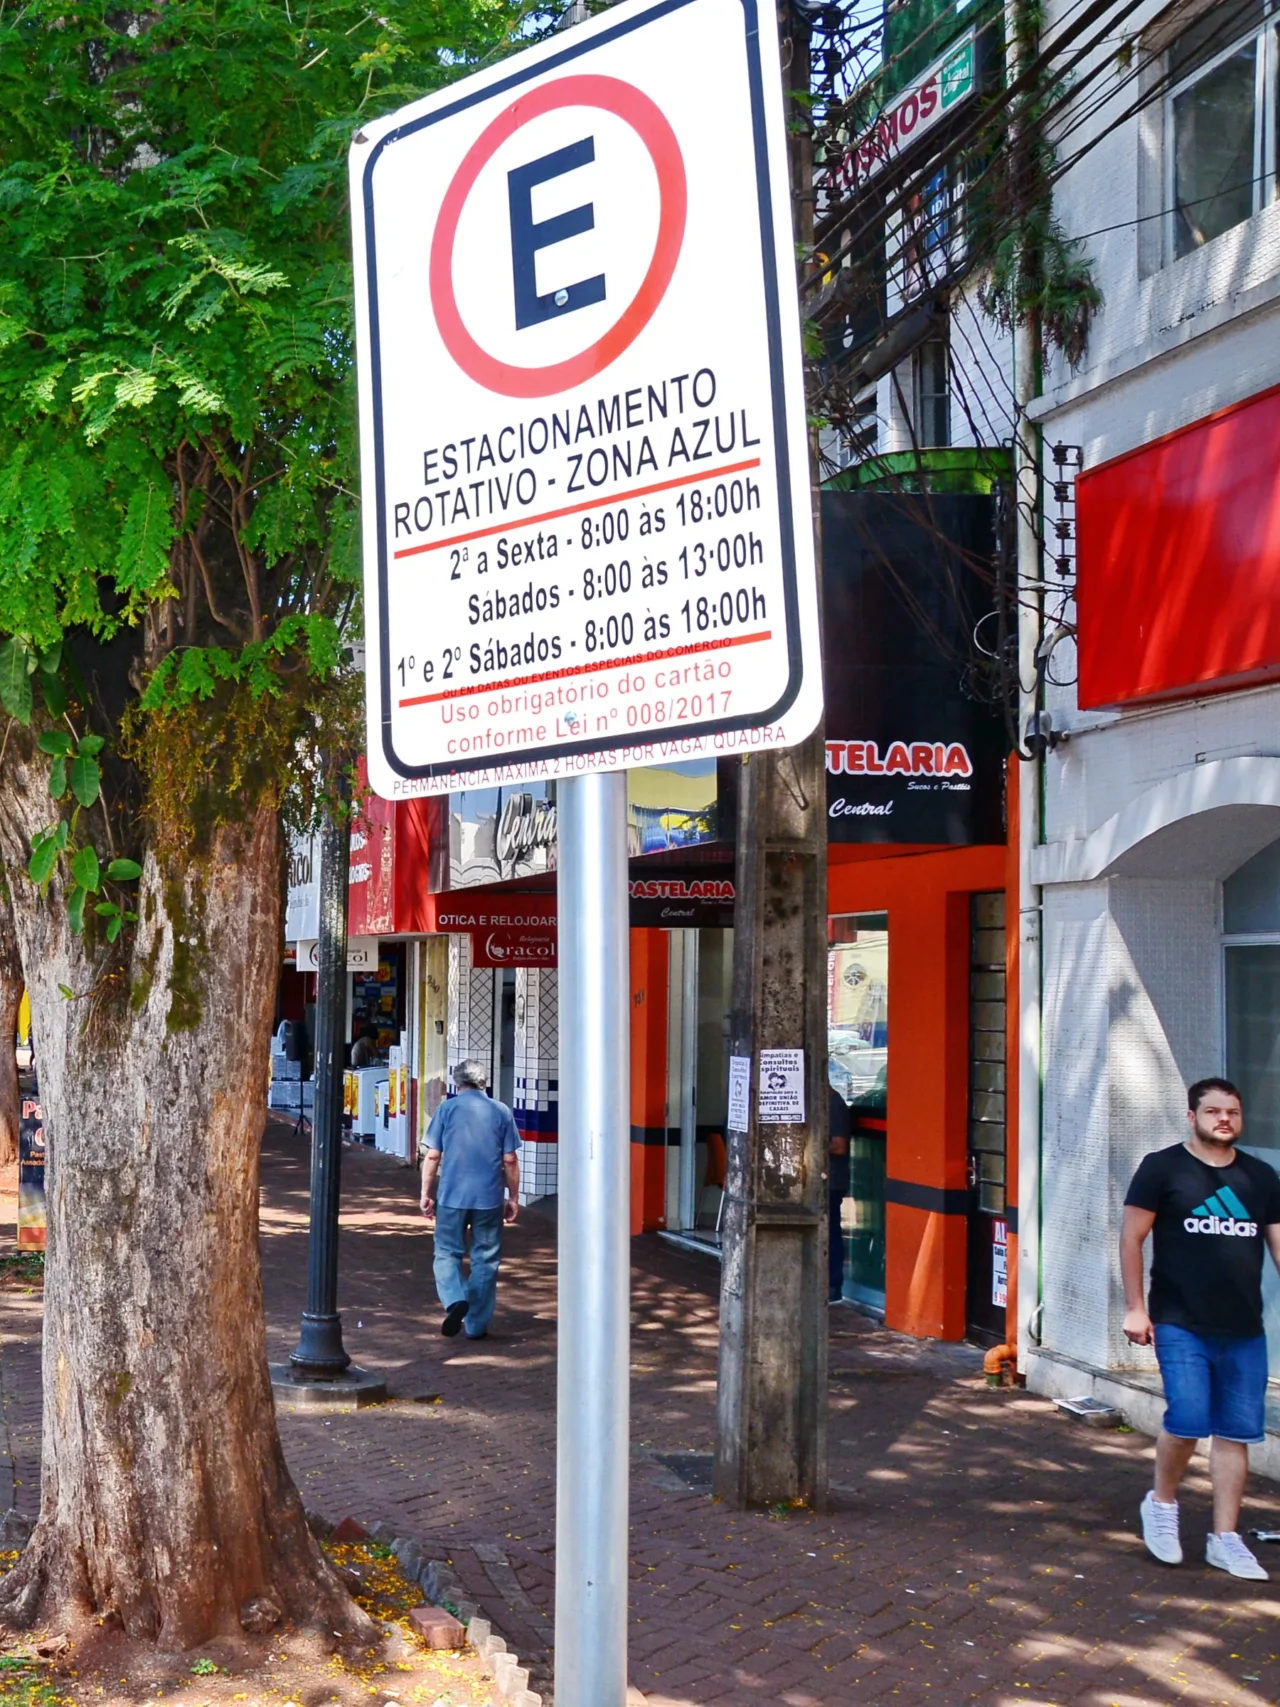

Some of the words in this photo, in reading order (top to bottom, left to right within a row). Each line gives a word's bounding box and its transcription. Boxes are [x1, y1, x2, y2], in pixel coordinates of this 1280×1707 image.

[507, 135, 606, 331] E
[424, 366, 716, 485] ESTACIONAMENTO
[394, 467, 537, 538] ROTATIVO
[566, 437, 658, 493] ZONA
[667, 408, 761, 468] AZUL
[477, 549, 489, 576] a
[496, 528, 559, 570] Sexta
[580, 507, 630, 550] 8:00
[639, 501, 666, 536] às
[676, 478, 762, 525] 18:00h
[467, 580, 561, 625] Sábados
[583, 559, 631, 601] 8:00
[641, 555, 668, 588] às
[422, 659, 435, 684] e
[469, 631, 562, 675] Sábados
[585, 612, 634, 653] 8:00
[644, 607, 671, 642] às
[681, 585, 767, 634] 18:00h
[440, 702, 480, 725] Uso
[487, 680, 610, 715] obrigatório
[617, 672, 646, 695] do
[654, 658, 733, 689] cartão
[442, 688, 458, 699] OU
[459, 685, 476, 697] EM
[477, 679, 511, 693] DATAS
[512, 675, 529, 686] OU
[531, 665, 582, 683] EVENTOS
[584, 654, 644, 673] ESPECIAIS
[647, 649, 664, 660] DO
[667, 637, 733, 657] COMERCIO
[446, 723, 548, 755] conforme
[555, 713, 588, 738] Lei
[596, 707, 618, 732] nº
[626, 689, 733, 728] 008/2017
[392, 768, 490, 795] PERMANÊNCIA
[494, 760, 549, 782] MÁXIMA
[553, 758, 561, 772] 2
[565, 749, 618, 771] HORAS
[621, 742, 655, 764] POR
[713, 725, 787, 750] QUADRA
[825, 740, 973, 777] TELARIA
[907, 781, 931, 791] Sucos
[828, 798, 894, 818] Central
[438, 914, 476, 925] OTICA
[479, 915, 487, 925] E
[660, 907, 695, 918] Central
[760, 1065, 800, 1073] spirituais
[1183, 1215, 1258, 1237] adidas
